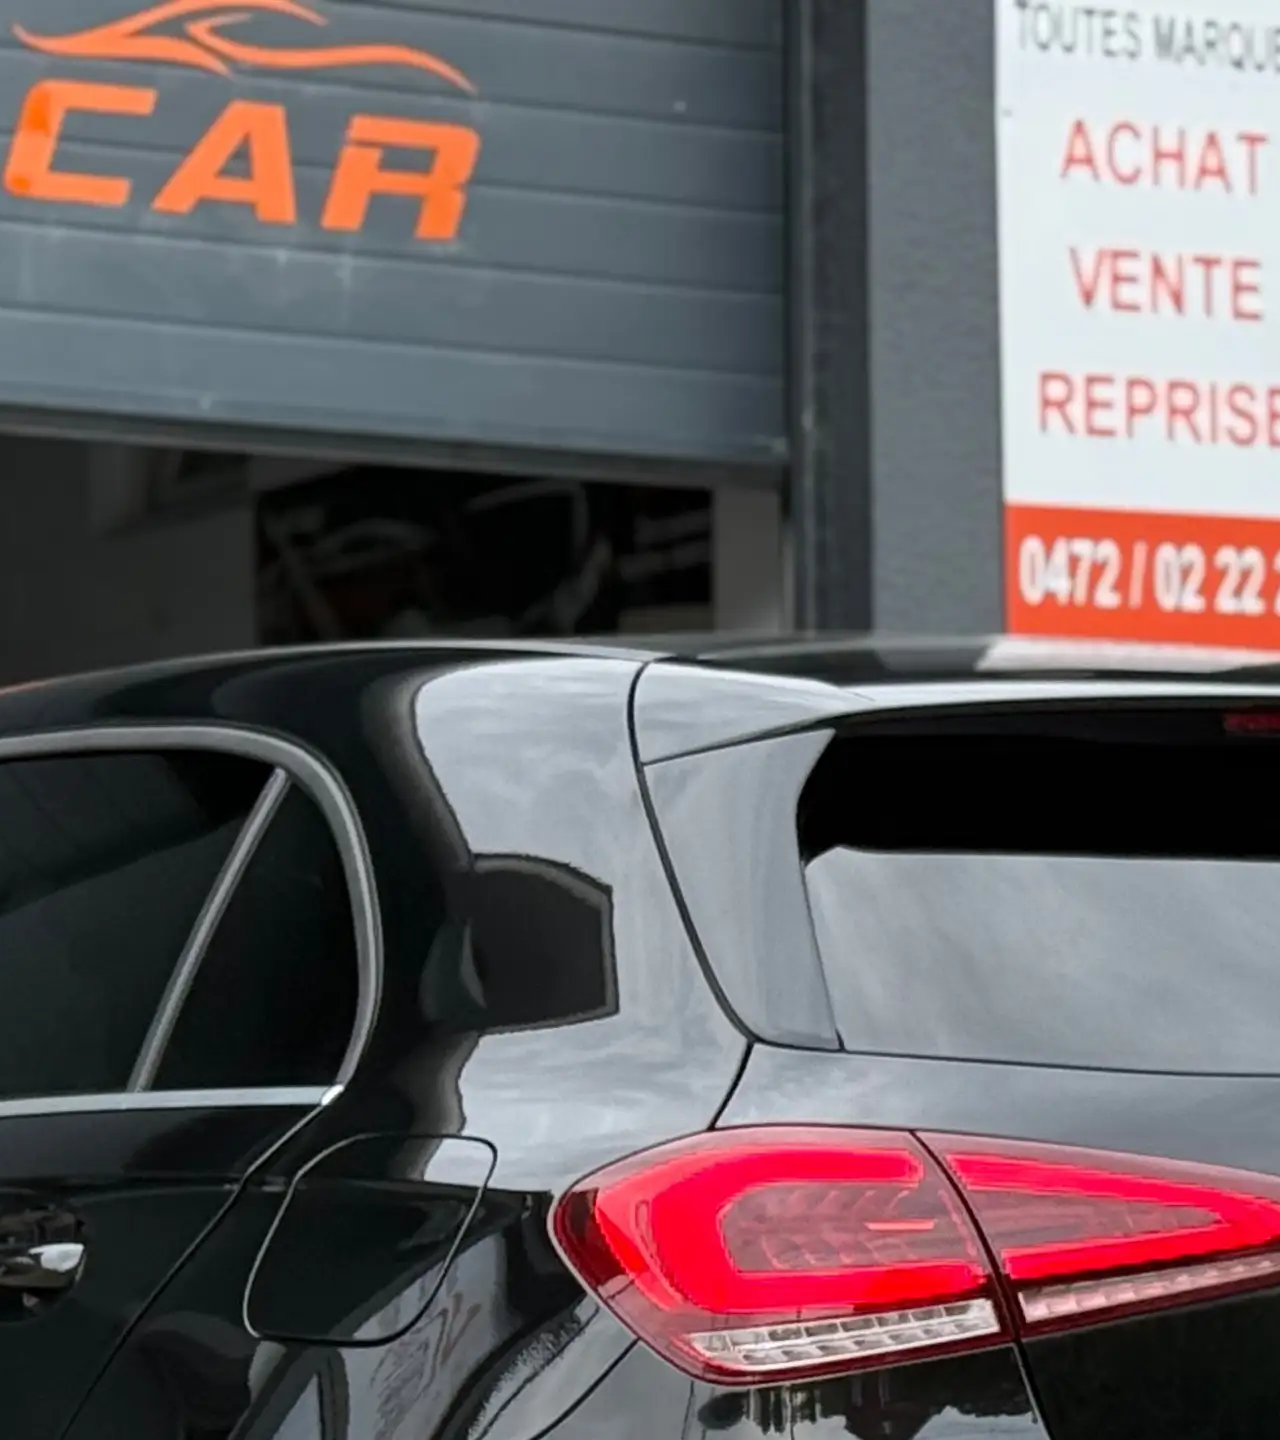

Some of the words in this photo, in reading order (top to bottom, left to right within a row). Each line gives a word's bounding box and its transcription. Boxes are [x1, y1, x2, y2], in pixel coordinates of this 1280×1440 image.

[1014, 0, 1142, 60] TOUTES
[2, 78, 481, 241] CAR
[1059, 117, 1269, 196] ACHAT
[1069, 246, 1265, 326] VENTE
[1213, 545, 1268, 617] 22
